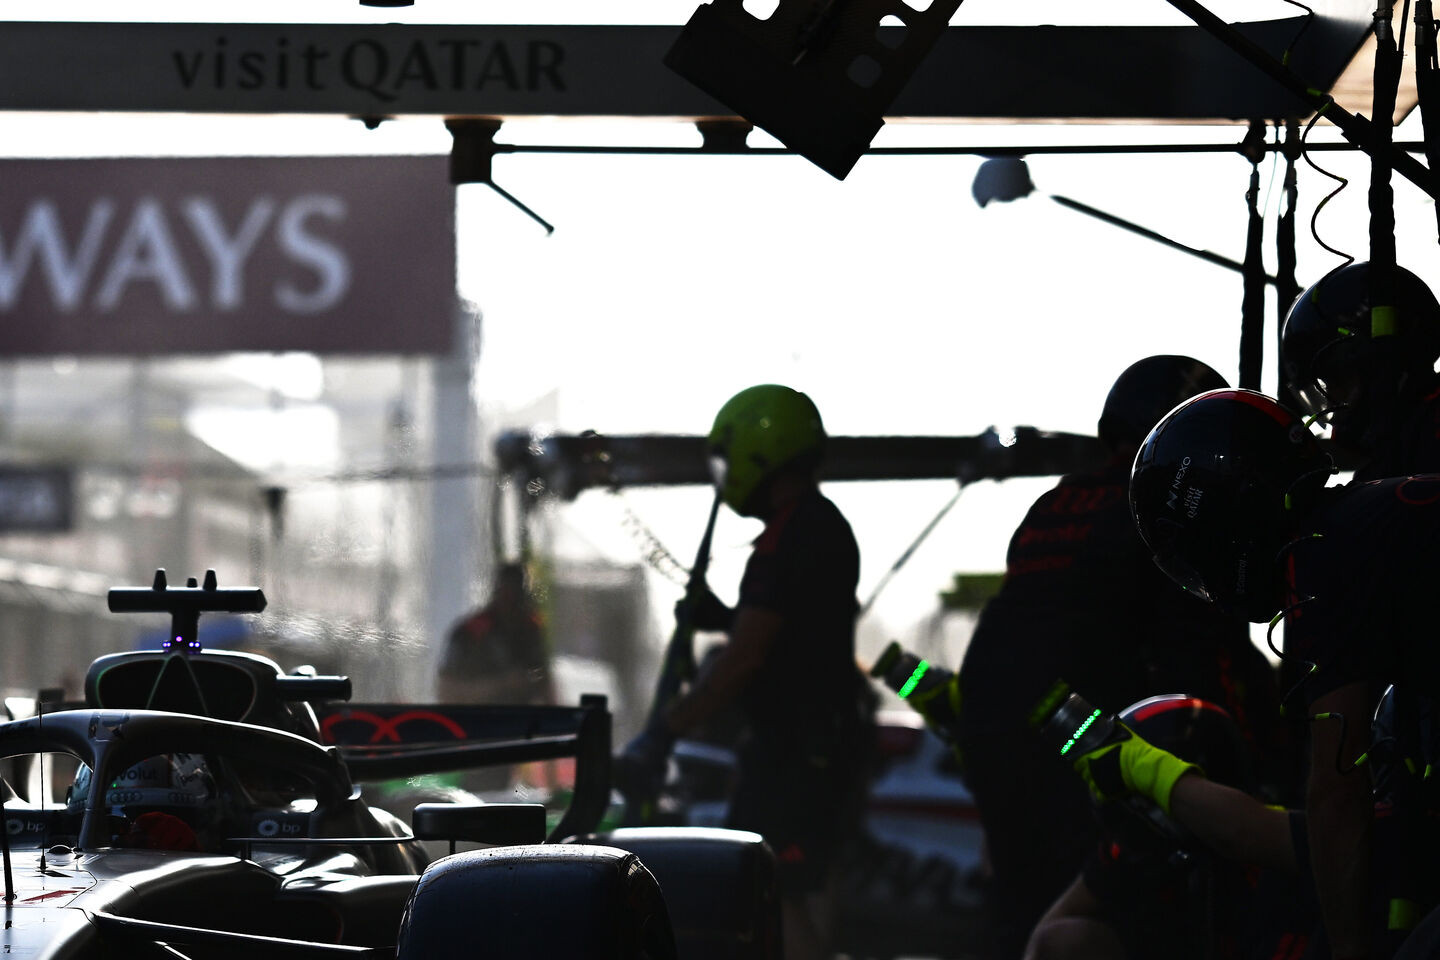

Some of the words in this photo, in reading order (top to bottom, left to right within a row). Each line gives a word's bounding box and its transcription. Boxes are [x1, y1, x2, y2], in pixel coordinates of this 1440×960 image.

[1172, 456, 1192, 490] NEXO
[118, 766, 158, 781] volut
[282, 821, 301, 834] bp
